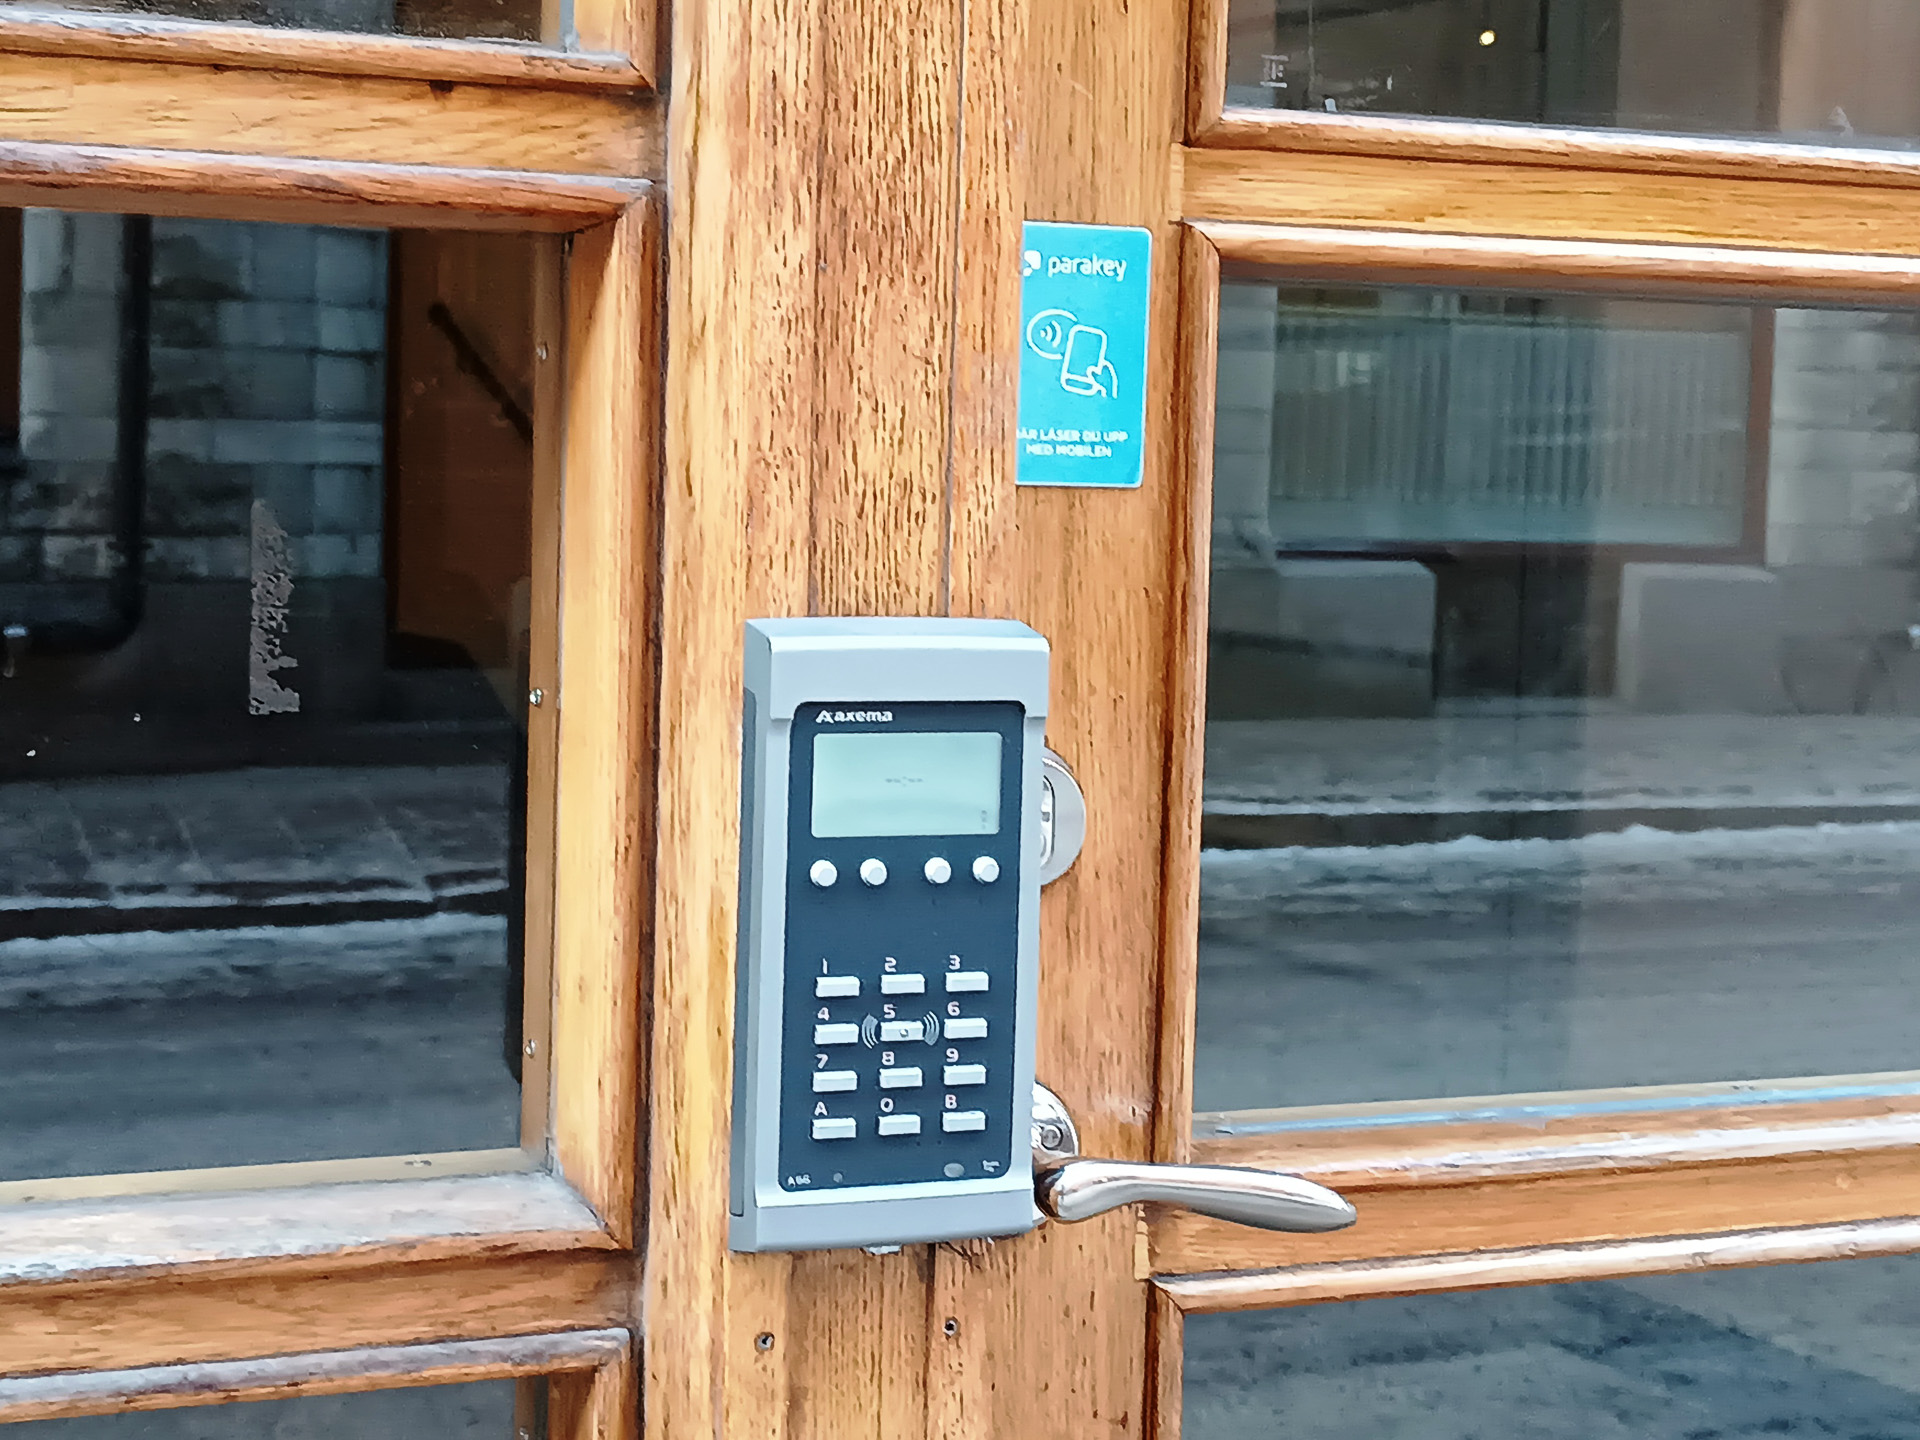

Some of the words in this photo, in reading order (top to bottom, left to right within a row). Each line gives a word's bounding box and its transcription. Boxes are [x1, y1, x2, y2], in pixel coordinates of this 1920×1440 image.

[1047, 253, 1127, 282] parakey
[1103, 430, 1129, 443] UPP
[1055, 444, 1112, 458] MOBILEN
[822, 957, 828, 975] 1
[884, 956, 897, 973] 2
[948, 954, 961, 970] 3
[817, 1006, 830, 1021] 4
[883, 1003, 897, 1019] 5
[947, 1001, 960, 1017] 6
[815, 1053, 829, 1069] 7
[881, 1051, 895, 1066] 8
[946, 1048, 959, 1063] 9
[814, 1101, 828, 1116] A
[944, 1094, 958, 1109] B
